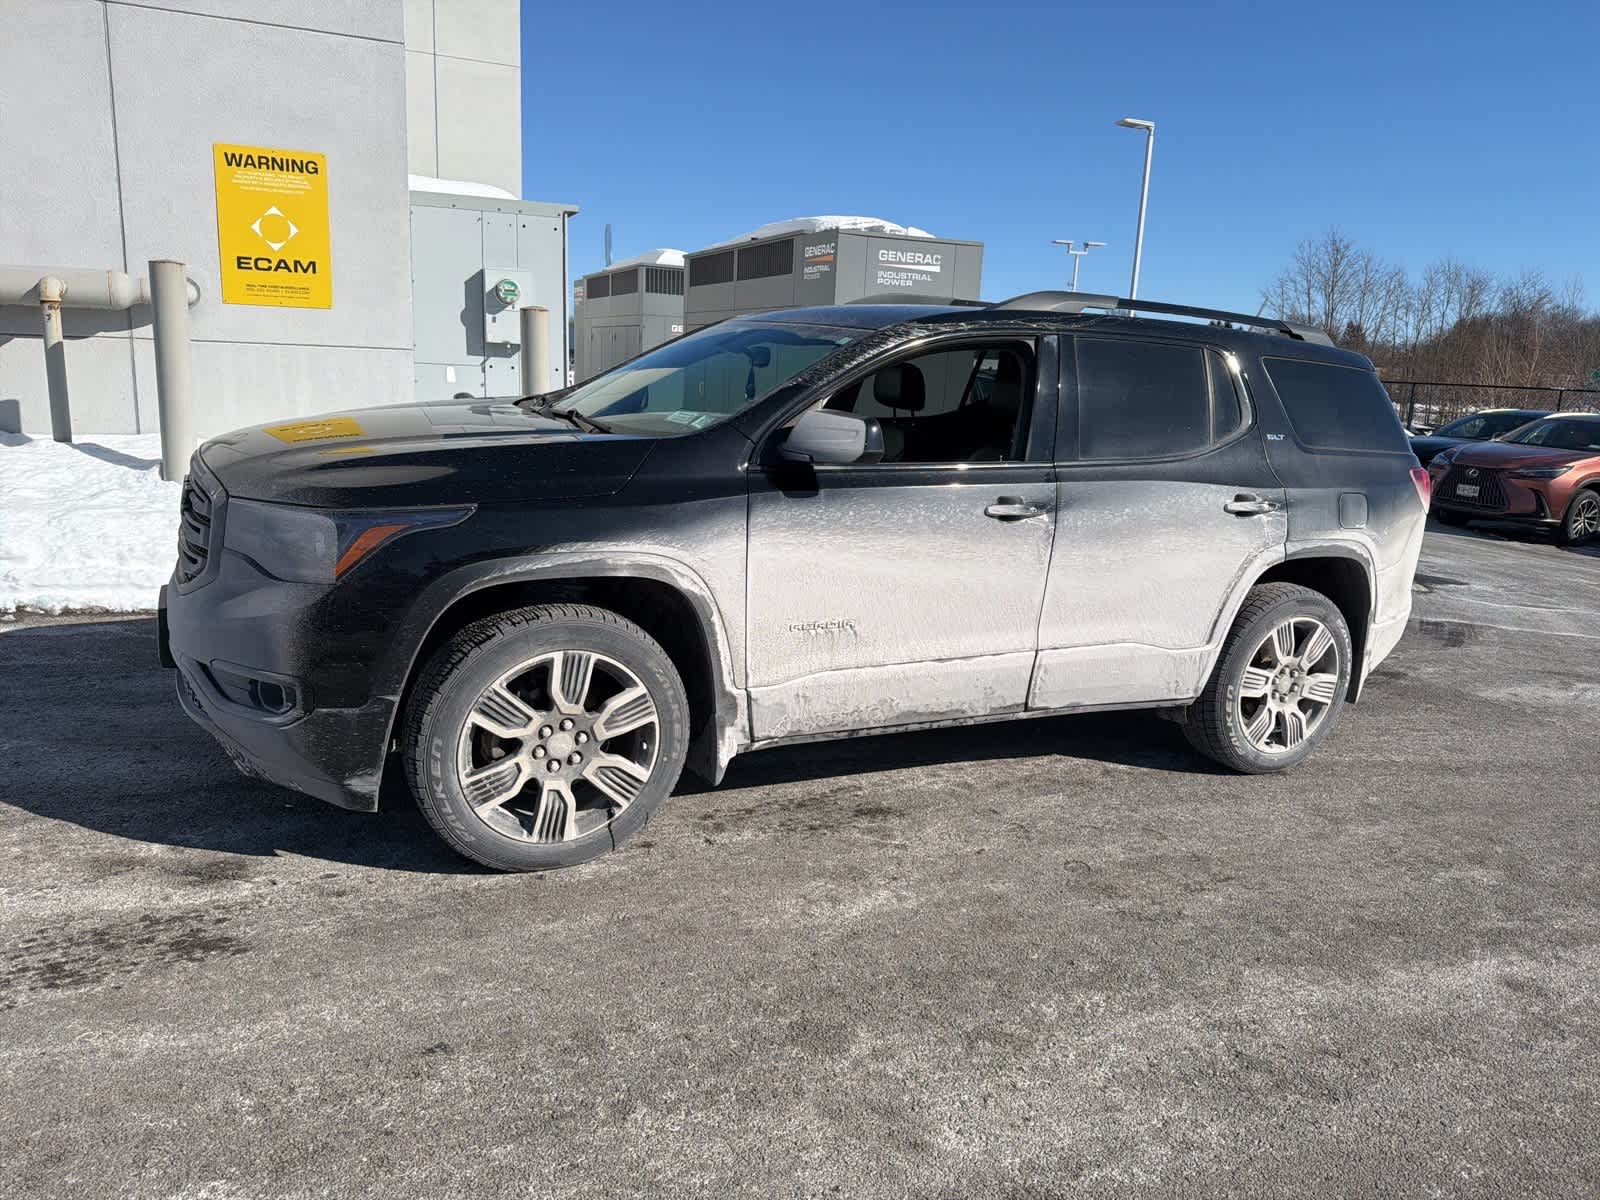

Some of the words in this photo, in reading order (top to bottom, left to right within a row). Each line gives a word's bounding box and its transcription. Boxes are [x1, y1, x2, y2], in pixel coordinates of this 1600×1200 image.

[224, 151, 319, 175] WARNING
[804, 243, 836, 257] GENERAC
[878, 249, 942, 265] GENERAC
[236, 256, 317, 274] ECAM
[876, 278, 913, 287] POWER
[877, 270, 933, 282] INDUSTRIAL
